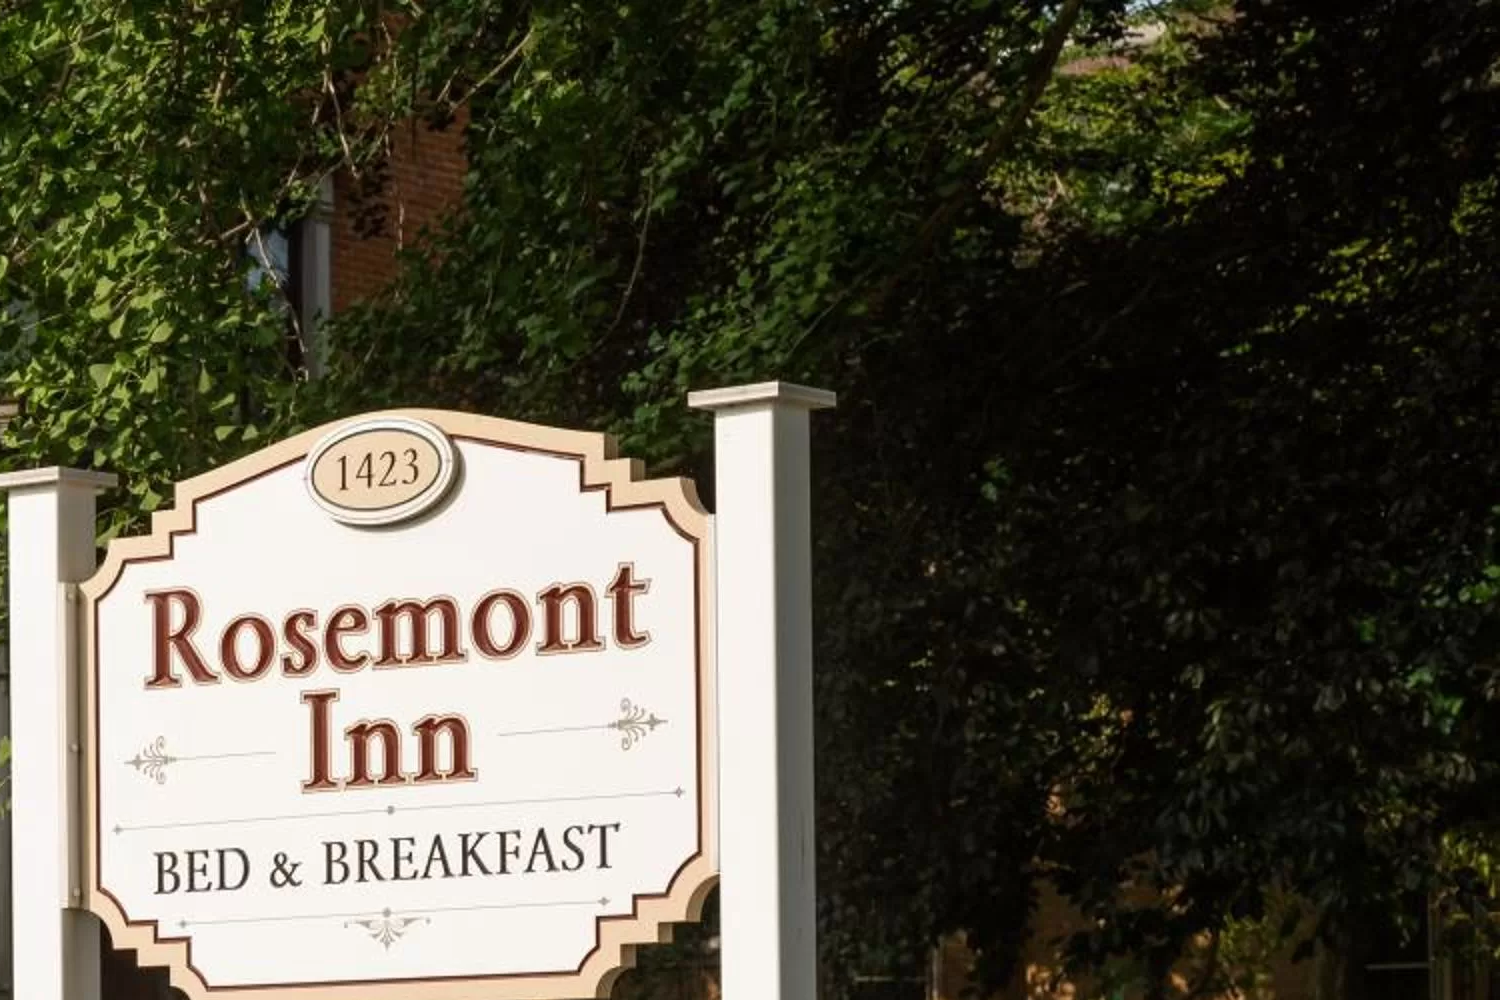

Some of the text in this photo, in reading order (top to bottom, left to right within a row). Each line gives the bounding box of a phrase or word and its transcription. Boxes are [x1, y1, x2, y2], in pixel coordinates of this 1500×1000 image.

[337, 447, 420, 492] 1423
[143, 561, 652, 690] Rosemont
[300, 687, 479, 794] Inn
[153, 821, 622, 896] BED & BREAKFAST
